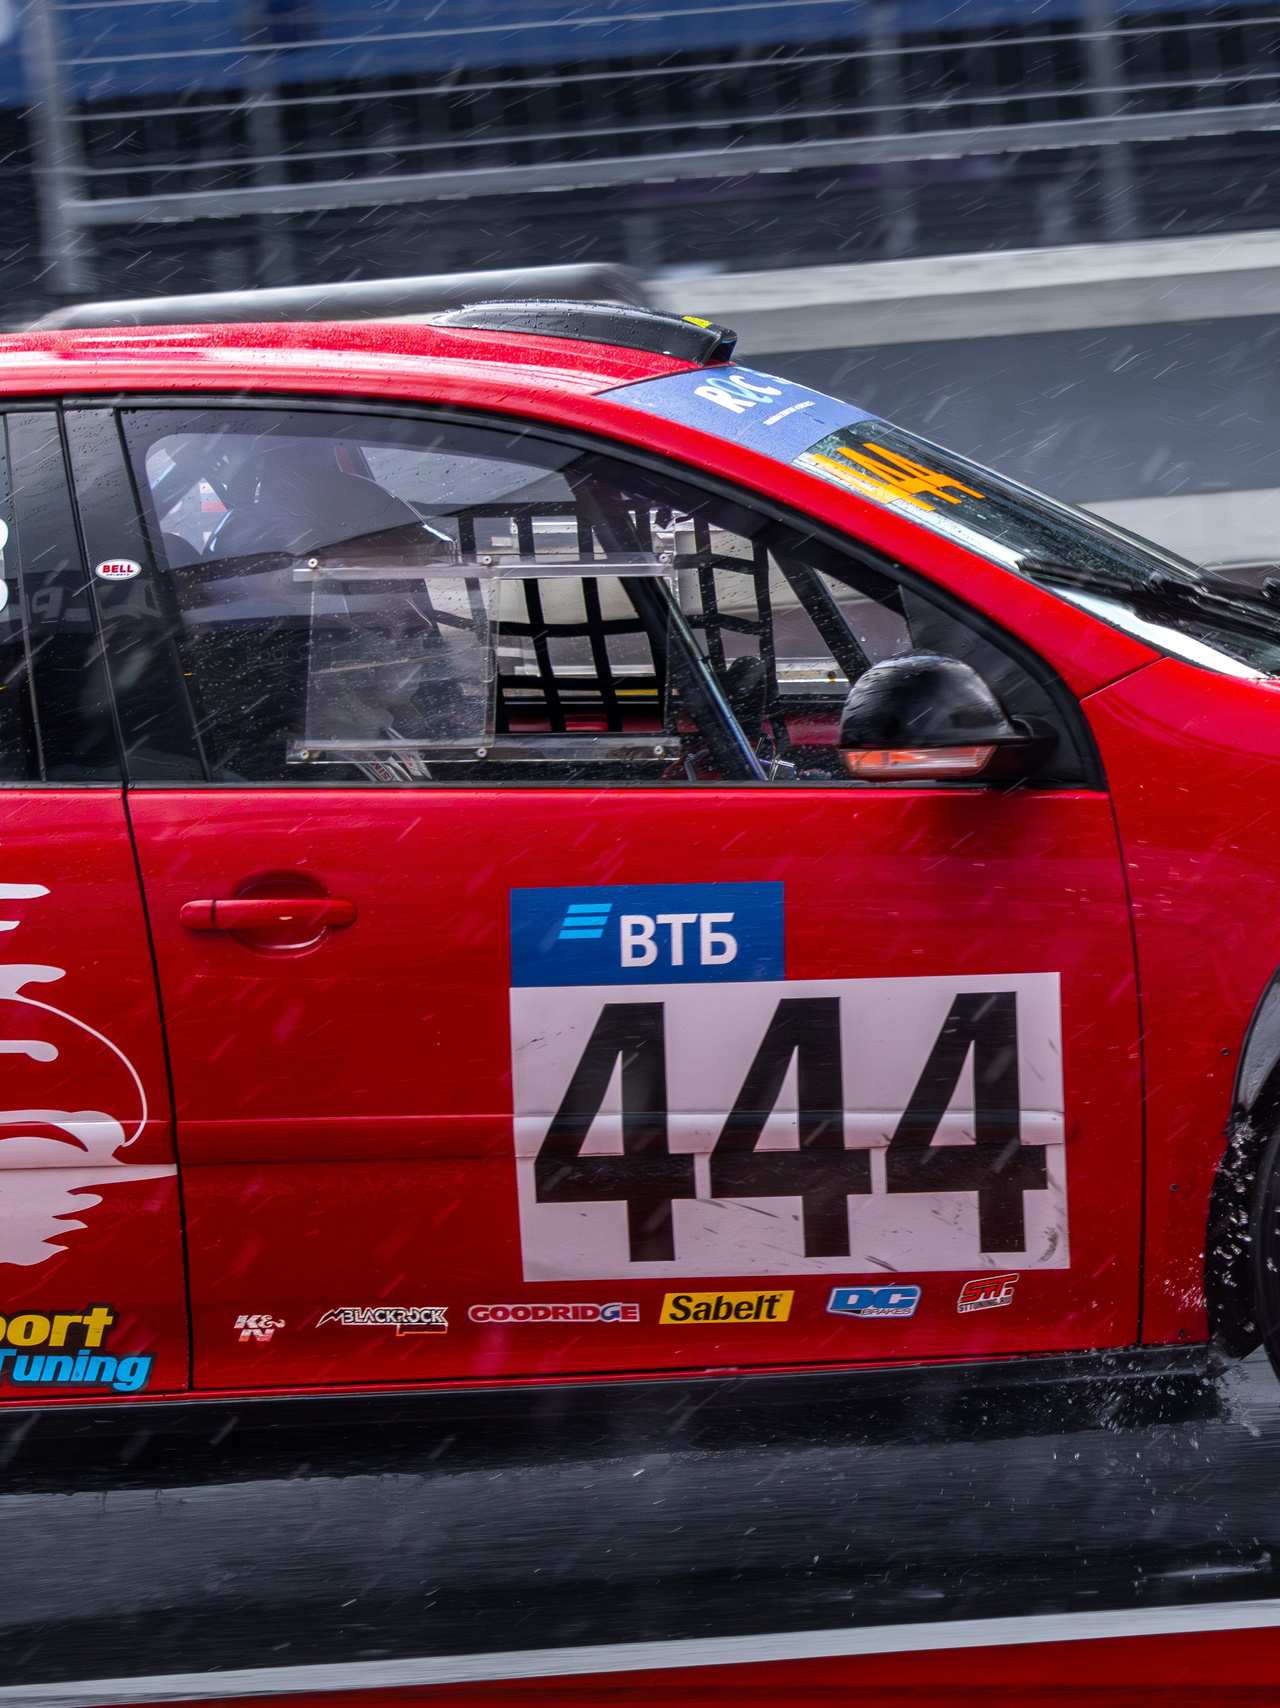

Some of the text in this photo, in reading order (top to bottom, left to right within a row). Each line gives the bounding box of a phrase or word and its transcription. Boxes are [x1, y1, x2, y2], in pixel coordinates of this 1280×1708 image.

[102, 565, 134, 573] BELL
[620, 912, 738, 968] ВТБ
[534, 991, 1048, 1262] 444
[669, 1294, 780, 1321] Sabelt
[830, 1289, 917, 1309] DC
[344, 1308, 443, 1324] BLACKROCK
[471, 1303, 638, 1322] GOODRIDGE
[861, 1308, 912, 1316] BRAKES
